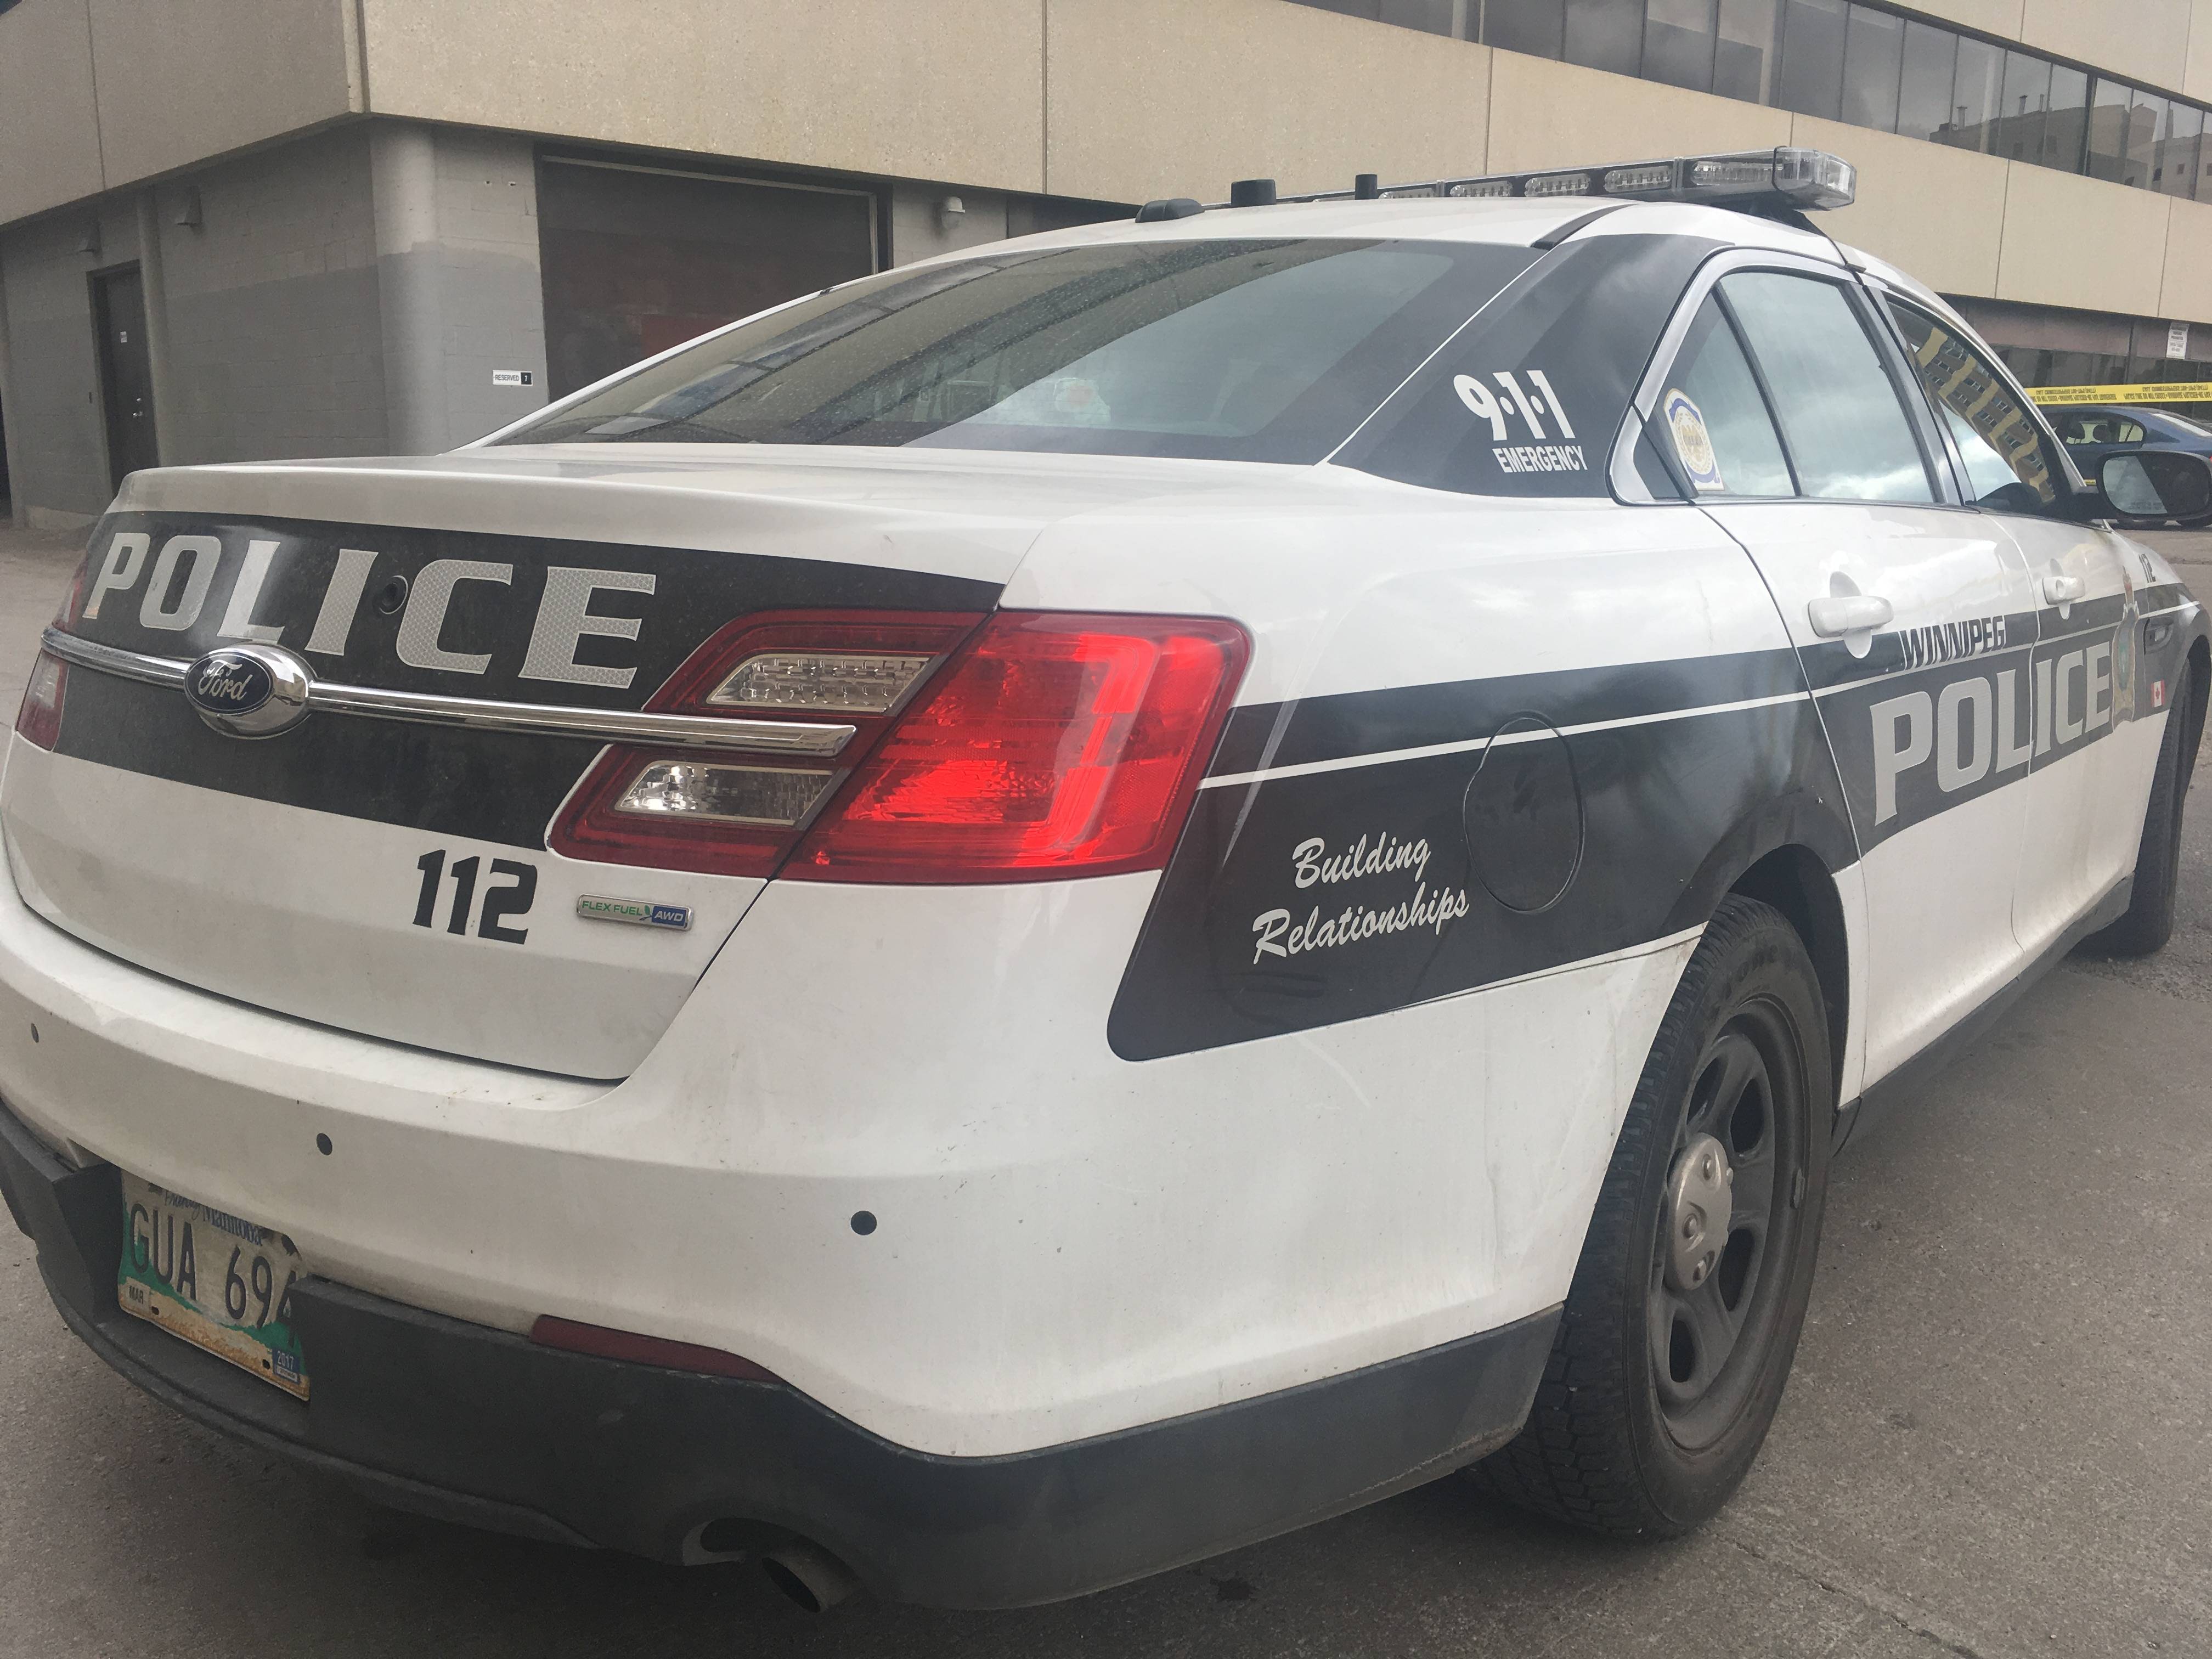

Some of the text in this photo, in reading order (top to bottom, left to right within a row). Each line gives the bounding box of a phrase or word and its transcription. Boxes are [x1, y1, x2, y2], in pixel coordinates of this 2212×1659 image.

[1492, 445, 1588, 473] EMERGENCY
[82, 532, 656, 690] POLICE
[1898, 614, 2007, 670] WINNIPEG
[198, 659, 253, 701] Ford
[1869, 641, 2112, 826] POLICE
[1292, 831, 1431, 888] Building
[413, 849, 538, 945] 112
[582, 900, 684, 922] FLEX FUEL AWD
[1252, 882, 1469, 964] Relationships
[131, 1203, 196, 1301] GUA
[129, 1284, 144, 1305] MAR
[276, 1350, 294, 1369] 2017
